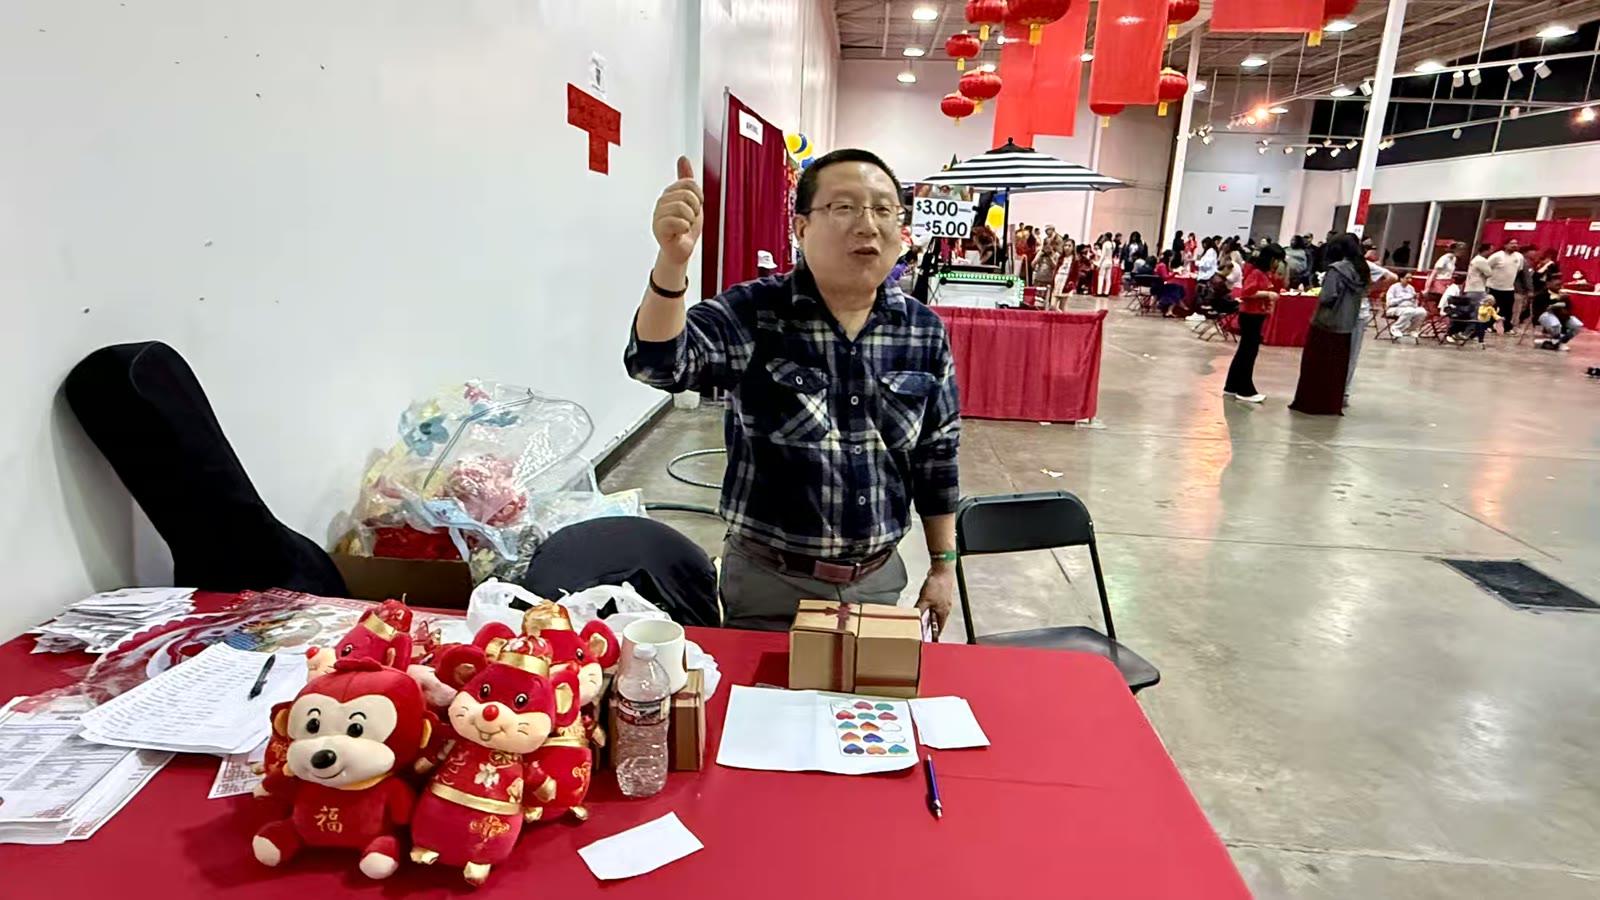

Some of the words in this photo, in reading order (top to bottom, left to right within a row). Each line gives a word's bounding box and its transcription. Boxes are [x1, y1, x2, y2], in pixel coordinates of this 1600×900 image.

[916, 199, 958, 217] $3.00
[925, 220, 967, 236] $5.00
[313, 805, 343, 833] 福
